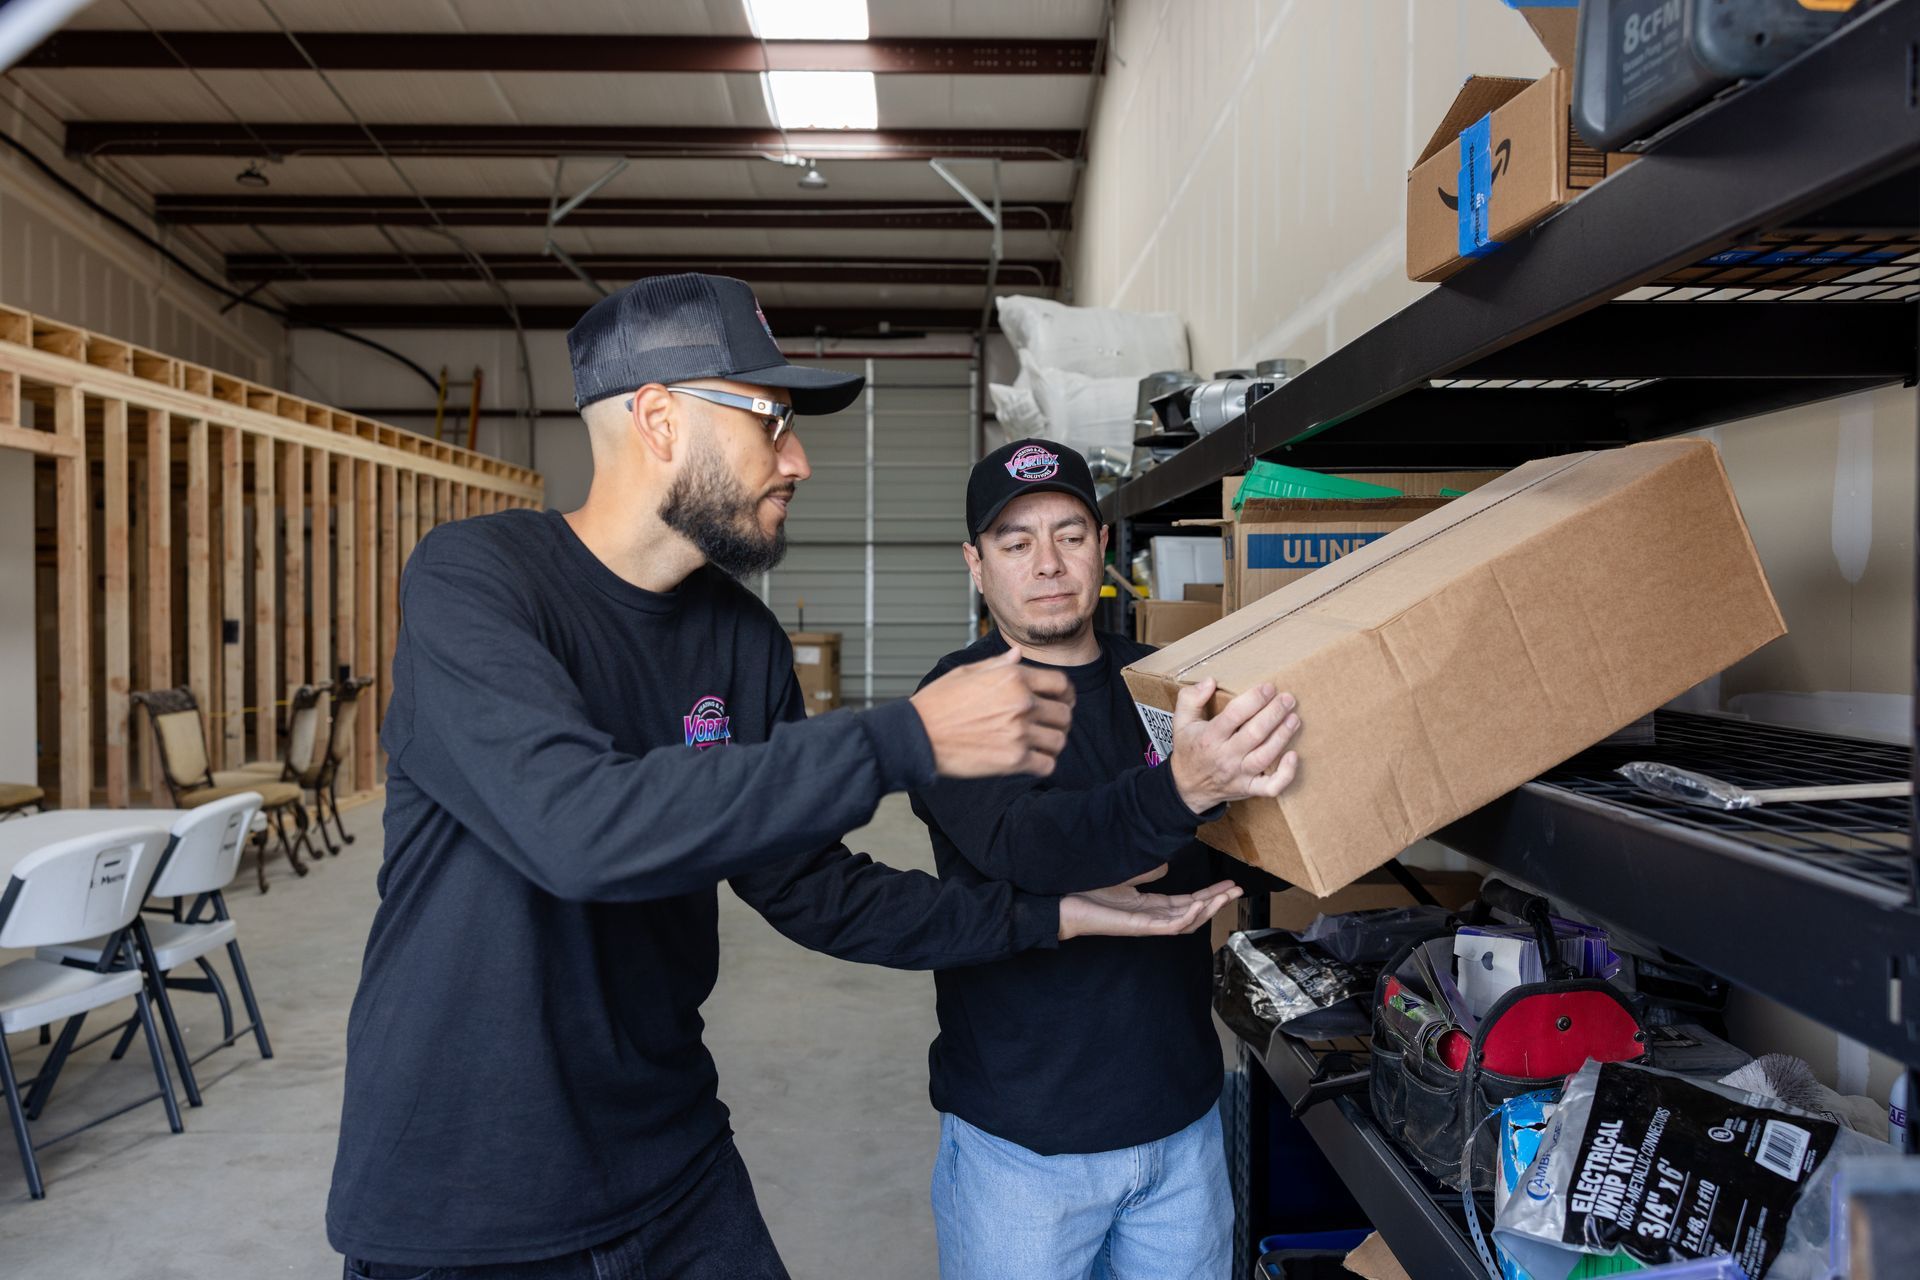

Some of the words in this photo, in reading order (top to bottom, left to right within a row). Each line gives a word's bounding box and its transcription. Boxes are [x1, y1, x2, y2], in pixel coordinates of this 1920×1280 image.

[1005, 454, 1060, 477] VORTEX
[1023, 469, 1052, 479] SOLUTIONS
[1526, 1120, 1562, 1200] CAMBGE
[1572, 1119, 1624, 1213] ELECTRICAL
[1609, 1143, 1638, 1174] KIT
[1616, 1153, 1652, 1230] NON-METALLIC
[1640, 1106, 1671, 1157] CONNECTORS
[1593, 1174, 1628, 1221] WHIP
[1637, 1190, 1673, 1239] 3/4"
[1656, 1157, 1684, 1182] 6'
[1696, 1179, 1716, 1202] #10
[1693, 1204, 1708, 1216] 1
[1681, 1240, 1698, 1253] 2
